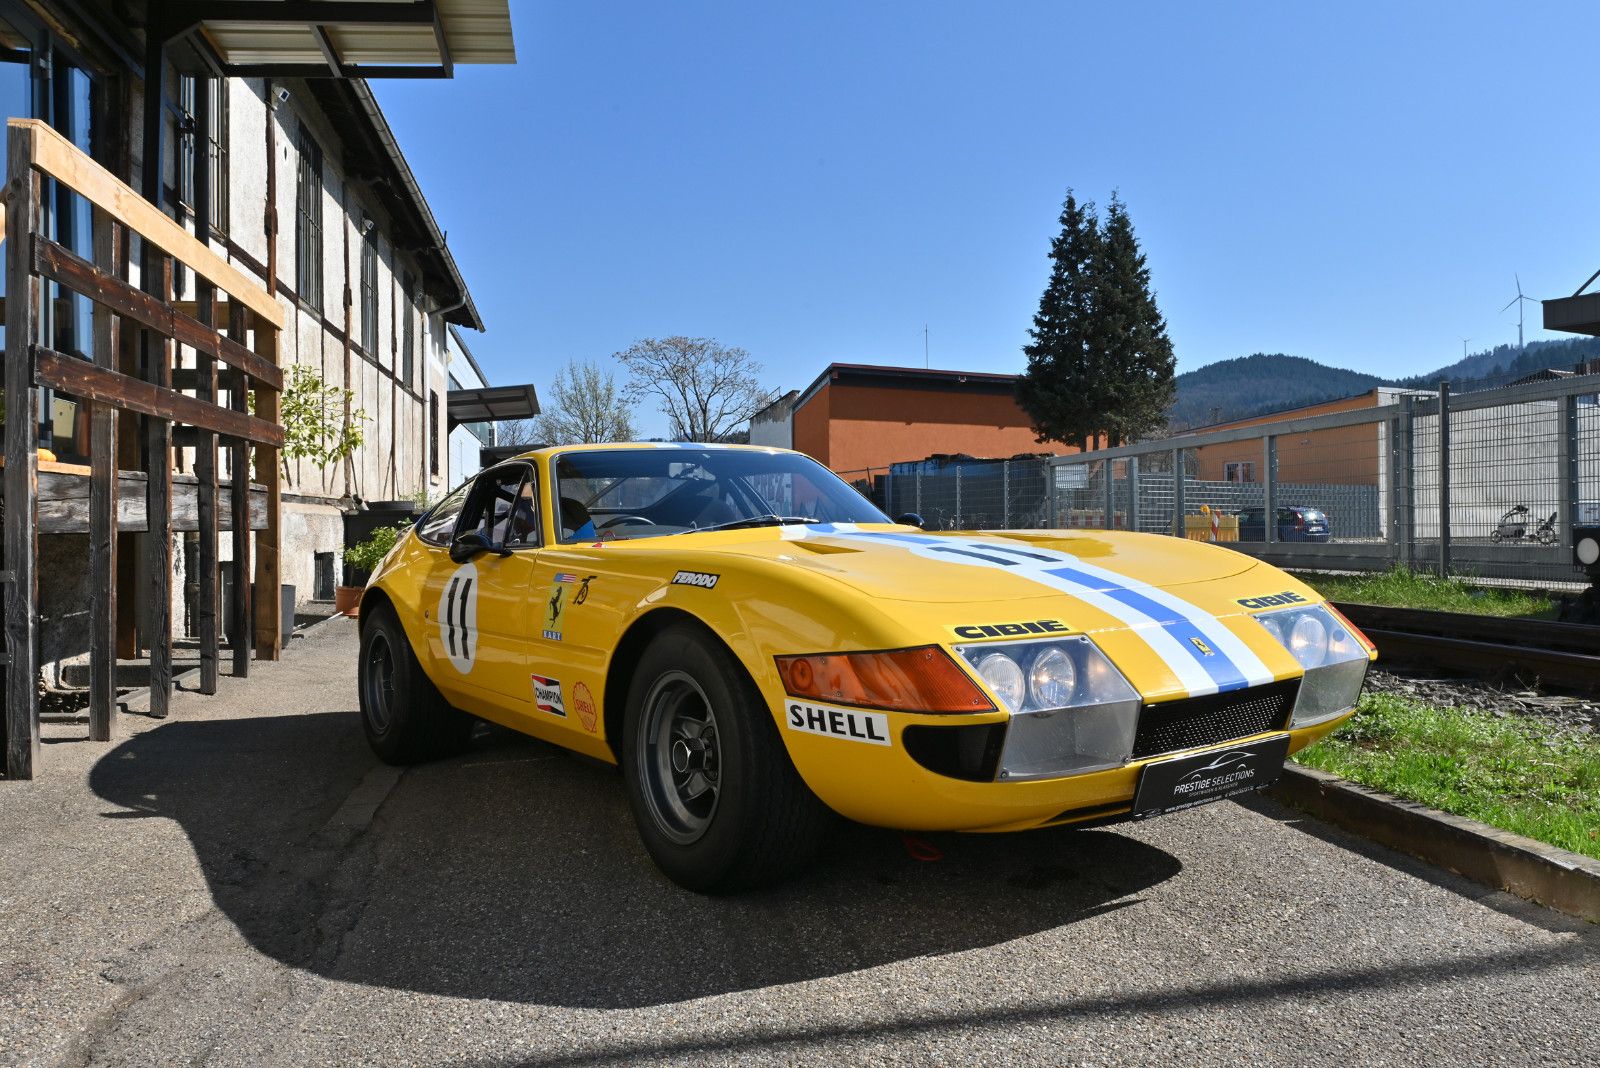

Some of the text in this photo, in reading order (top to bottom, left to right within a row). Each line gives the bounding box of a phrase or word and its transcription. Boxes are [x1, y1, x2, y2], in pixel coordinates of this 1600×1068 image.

[926, 544, 1064, 566] 11
[672, 571, 718, 588] FERODO
[446, 576, 473, 660] 11
[535, 686, 562, 704] CHAMPION
[575, 699, 594, 715] SHELL
[789, 704, 886, 742] SHELL
[1173, 778, 1211, 795] PRESTIGE
[1211, 768, 1256, 786] SELECTIONS
